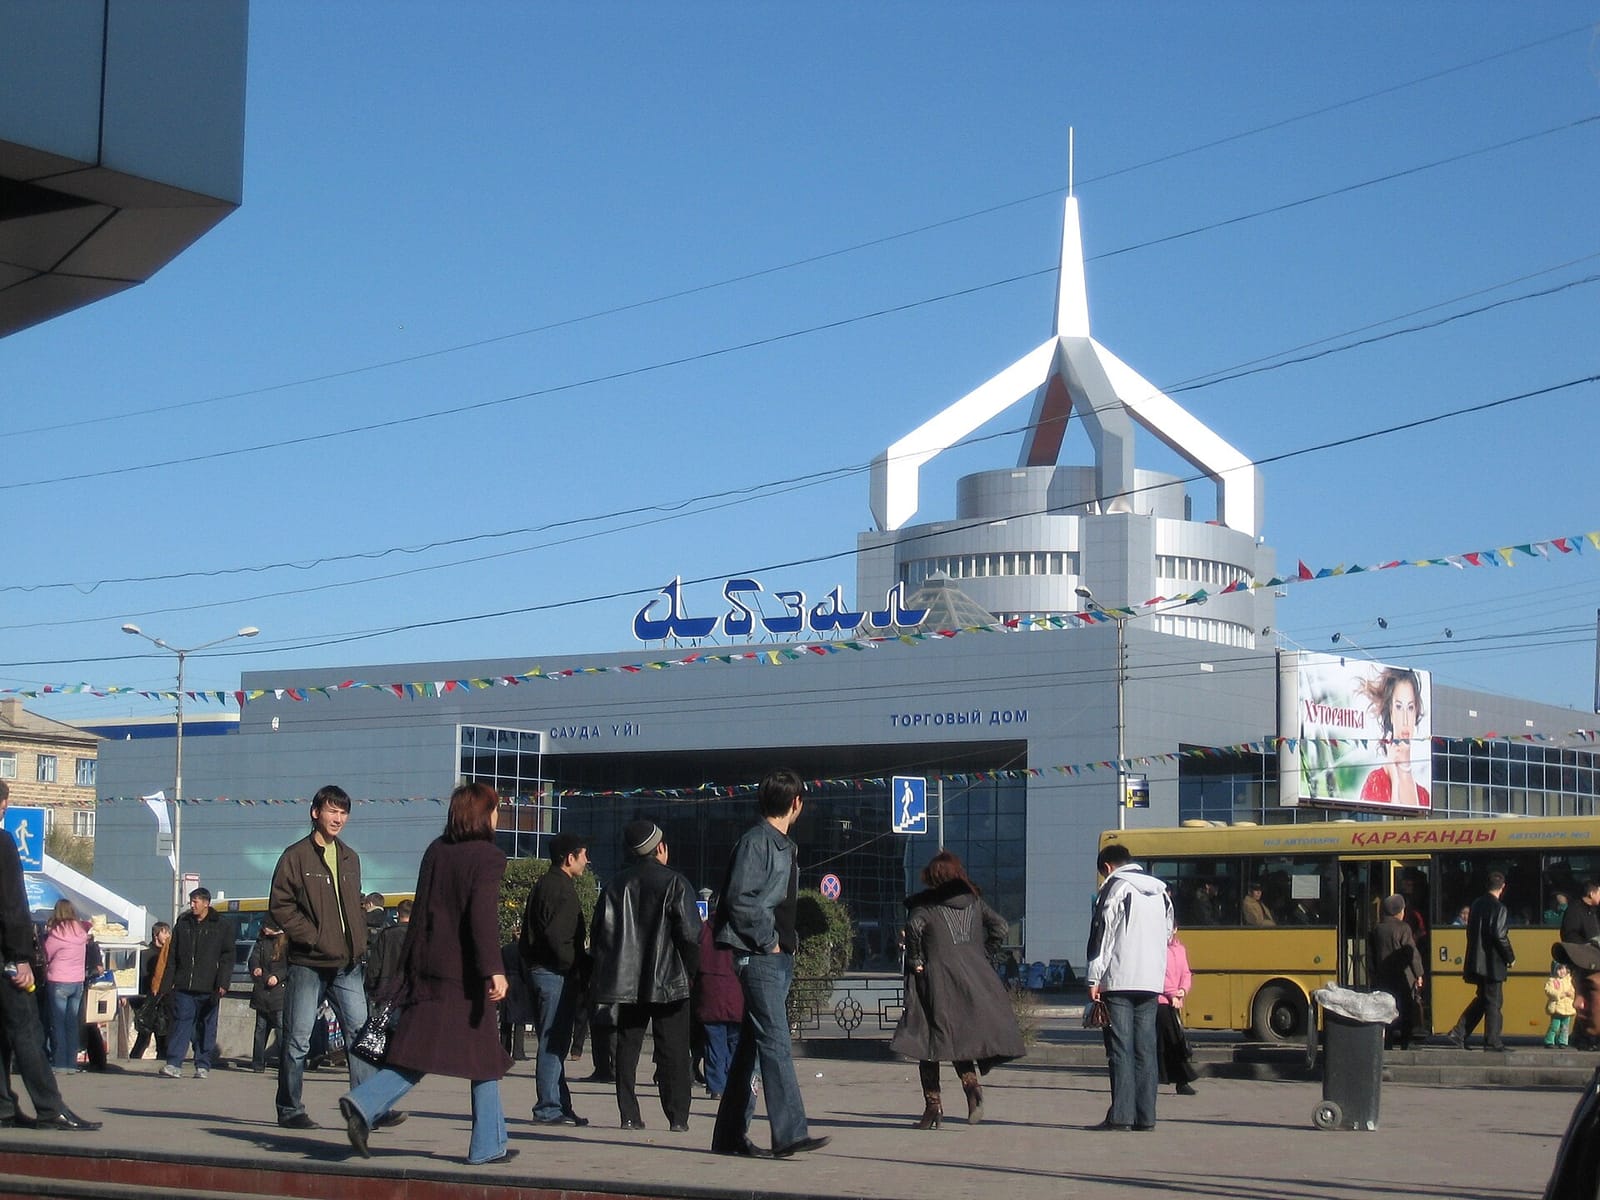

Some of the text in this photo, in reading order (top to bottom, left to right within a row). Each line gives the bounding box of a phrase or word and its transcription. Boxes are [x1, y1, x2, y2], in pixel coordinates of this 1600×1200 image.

[890, 708, 1029, 727] ТОРГОВЫЙ ДОМ
[550, 725, 601, 740] САУДА
[1352, 829, 1497, 847] ҚАРАҒАНДЫ
